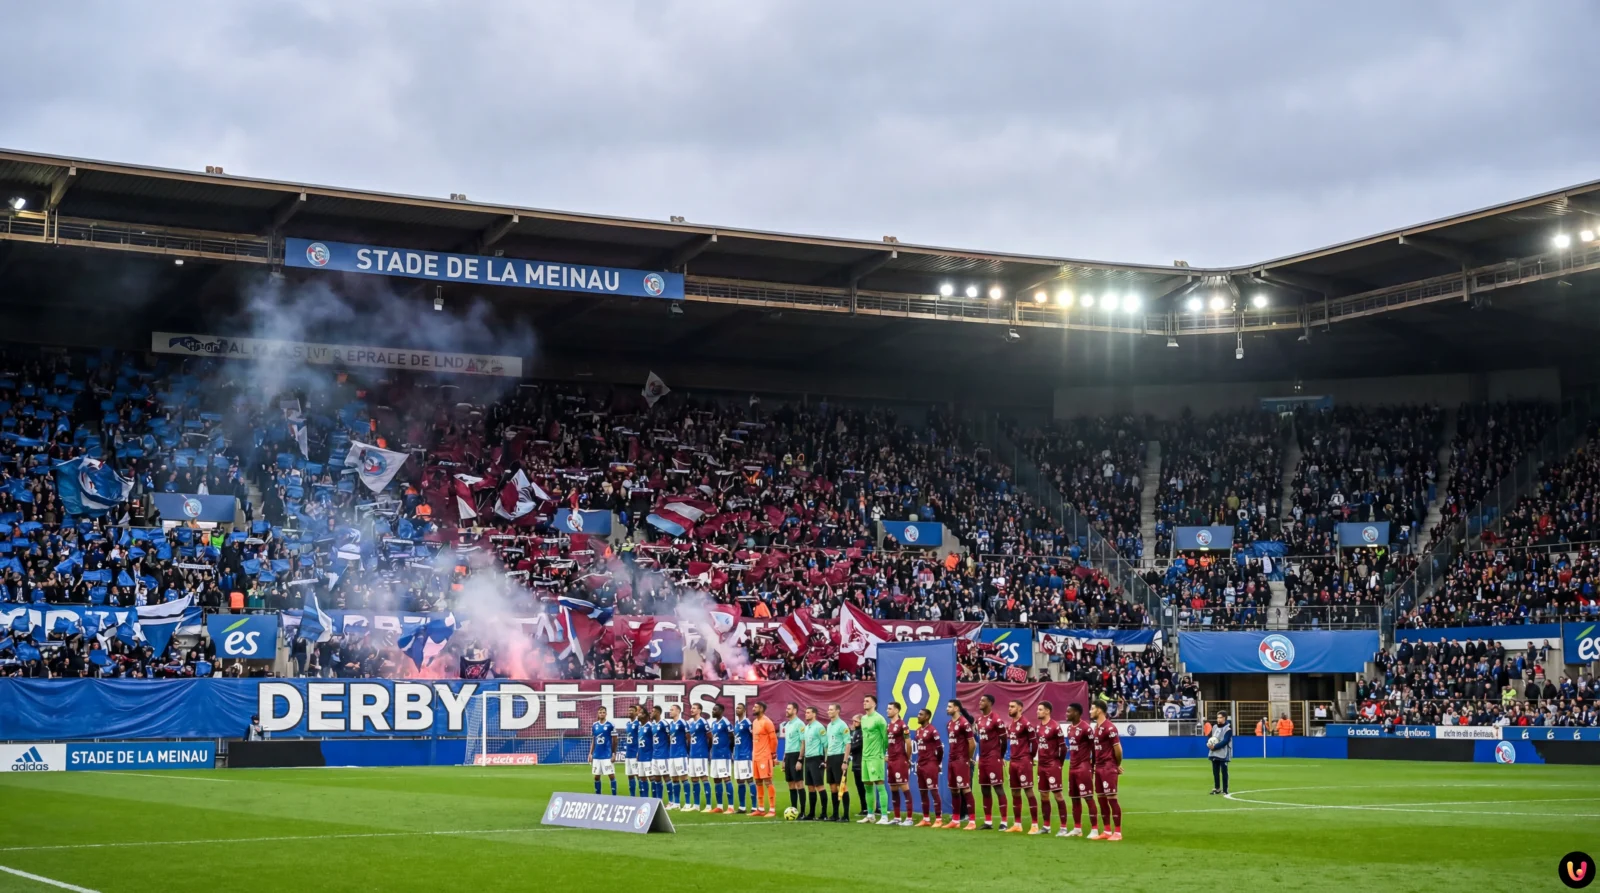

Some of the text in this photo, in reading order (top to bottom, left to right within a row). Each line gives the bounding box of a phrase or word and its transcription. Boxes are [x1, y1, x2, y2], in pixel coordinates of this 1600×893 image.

[356, 248, 620, 291] STADE DE LA MEINAU
[258, 682, 478, 731] DERBY
[499, 683, 579, 730] DE
[11, 762, 49, 771] adidas
[71, 749, 208, 764] STADE DE LA MEINAU
[560, 801, 636, 824] DERBY DE L'EST
